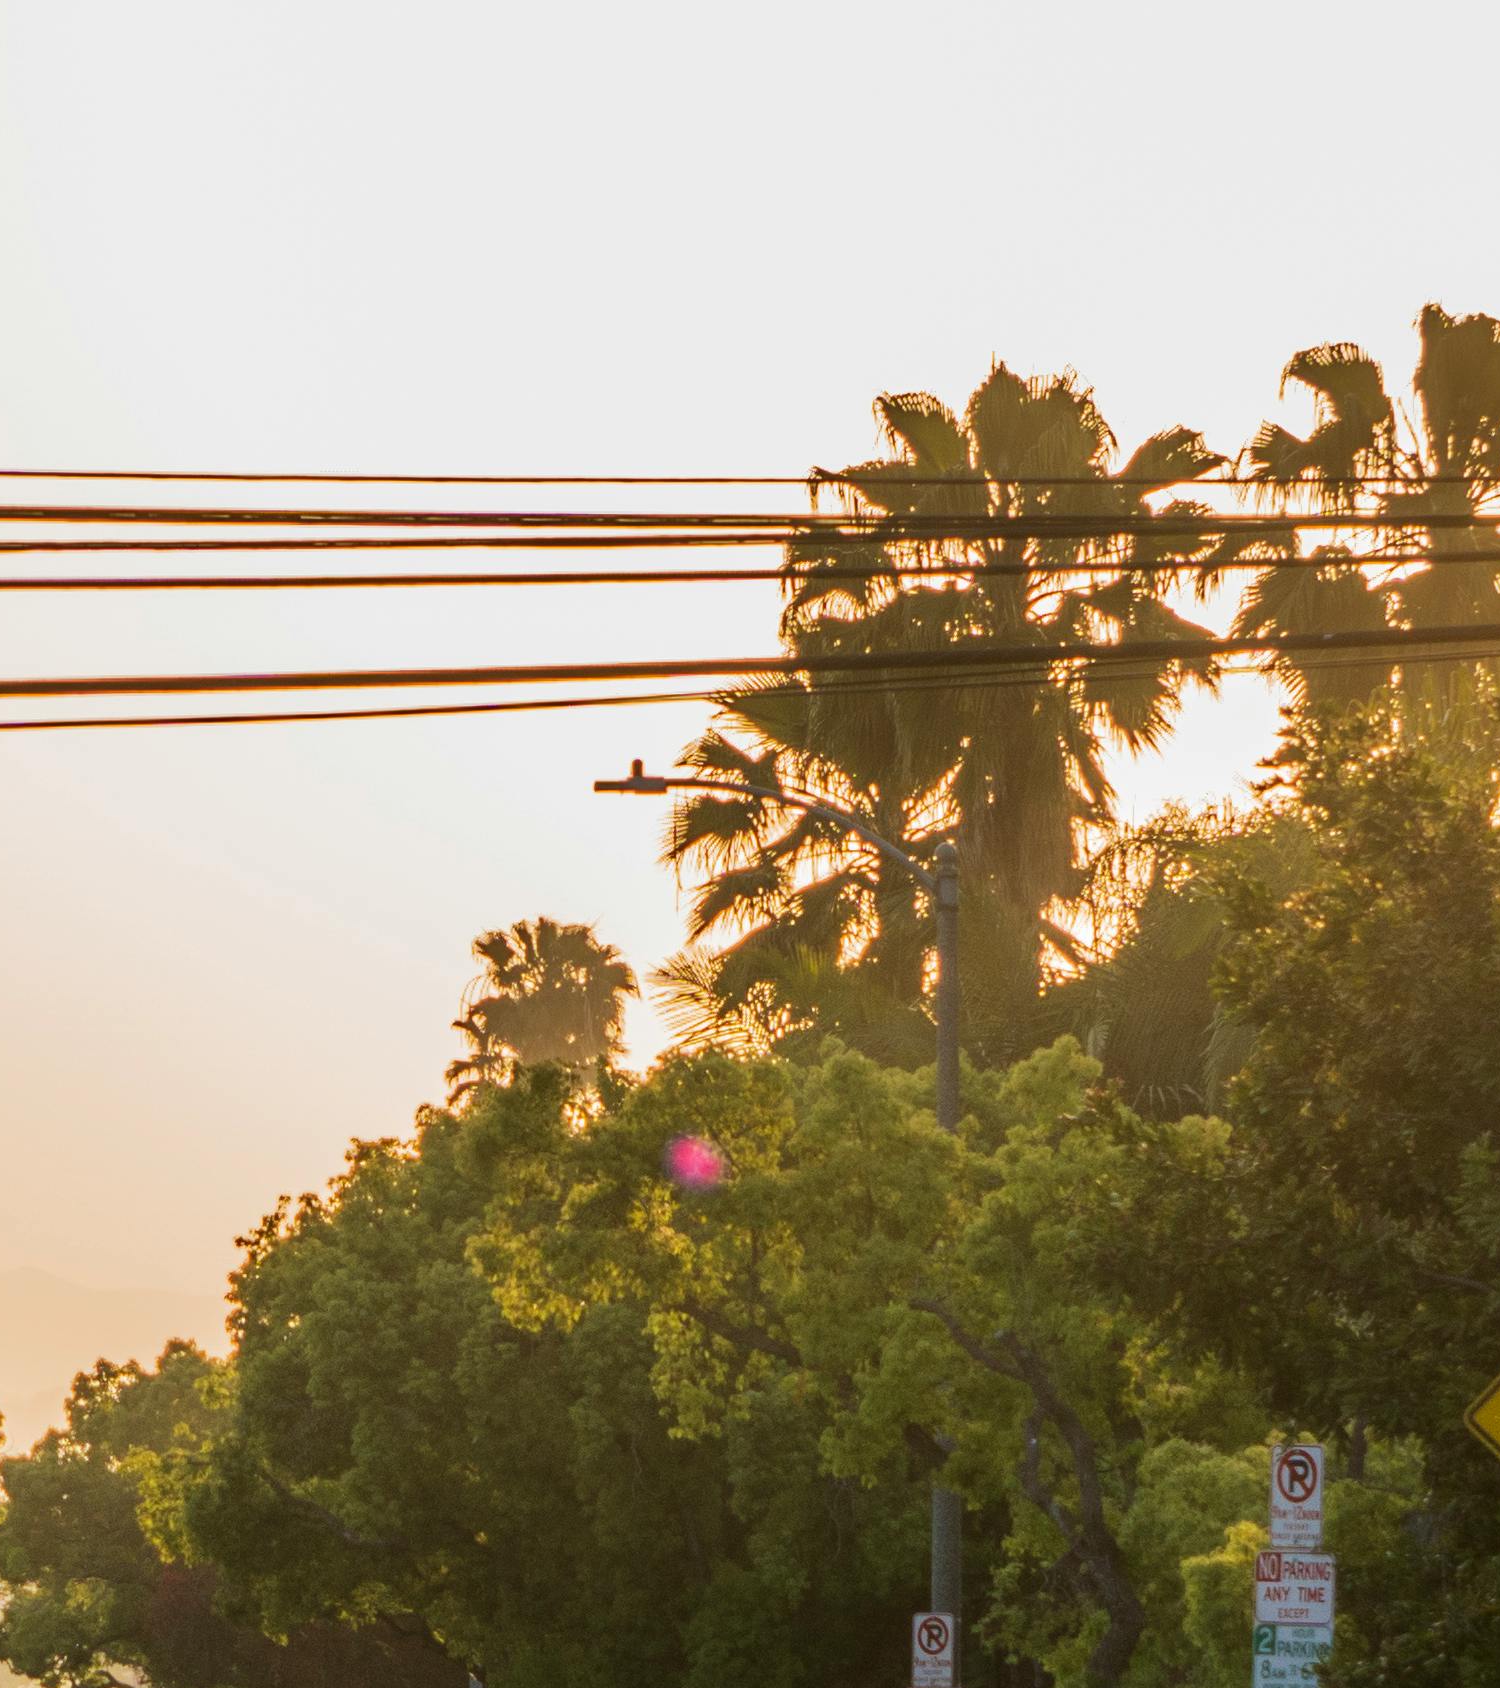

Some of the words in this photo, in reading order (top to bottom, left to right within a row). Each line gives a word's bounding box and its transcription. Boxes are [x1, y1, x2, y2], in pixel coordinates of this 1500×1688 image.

[1259, 1554, 1279, 1580] NO
[1283, 1561, 1331, 1581] PARKING
[1264, 1586, 1290, 1602] ANY
[1297, 1587, 1326, 1603] TIME
[1277, 1608, 1310, 1619] EXCEPT
[1258, 1626, 1273, 1653] 2
